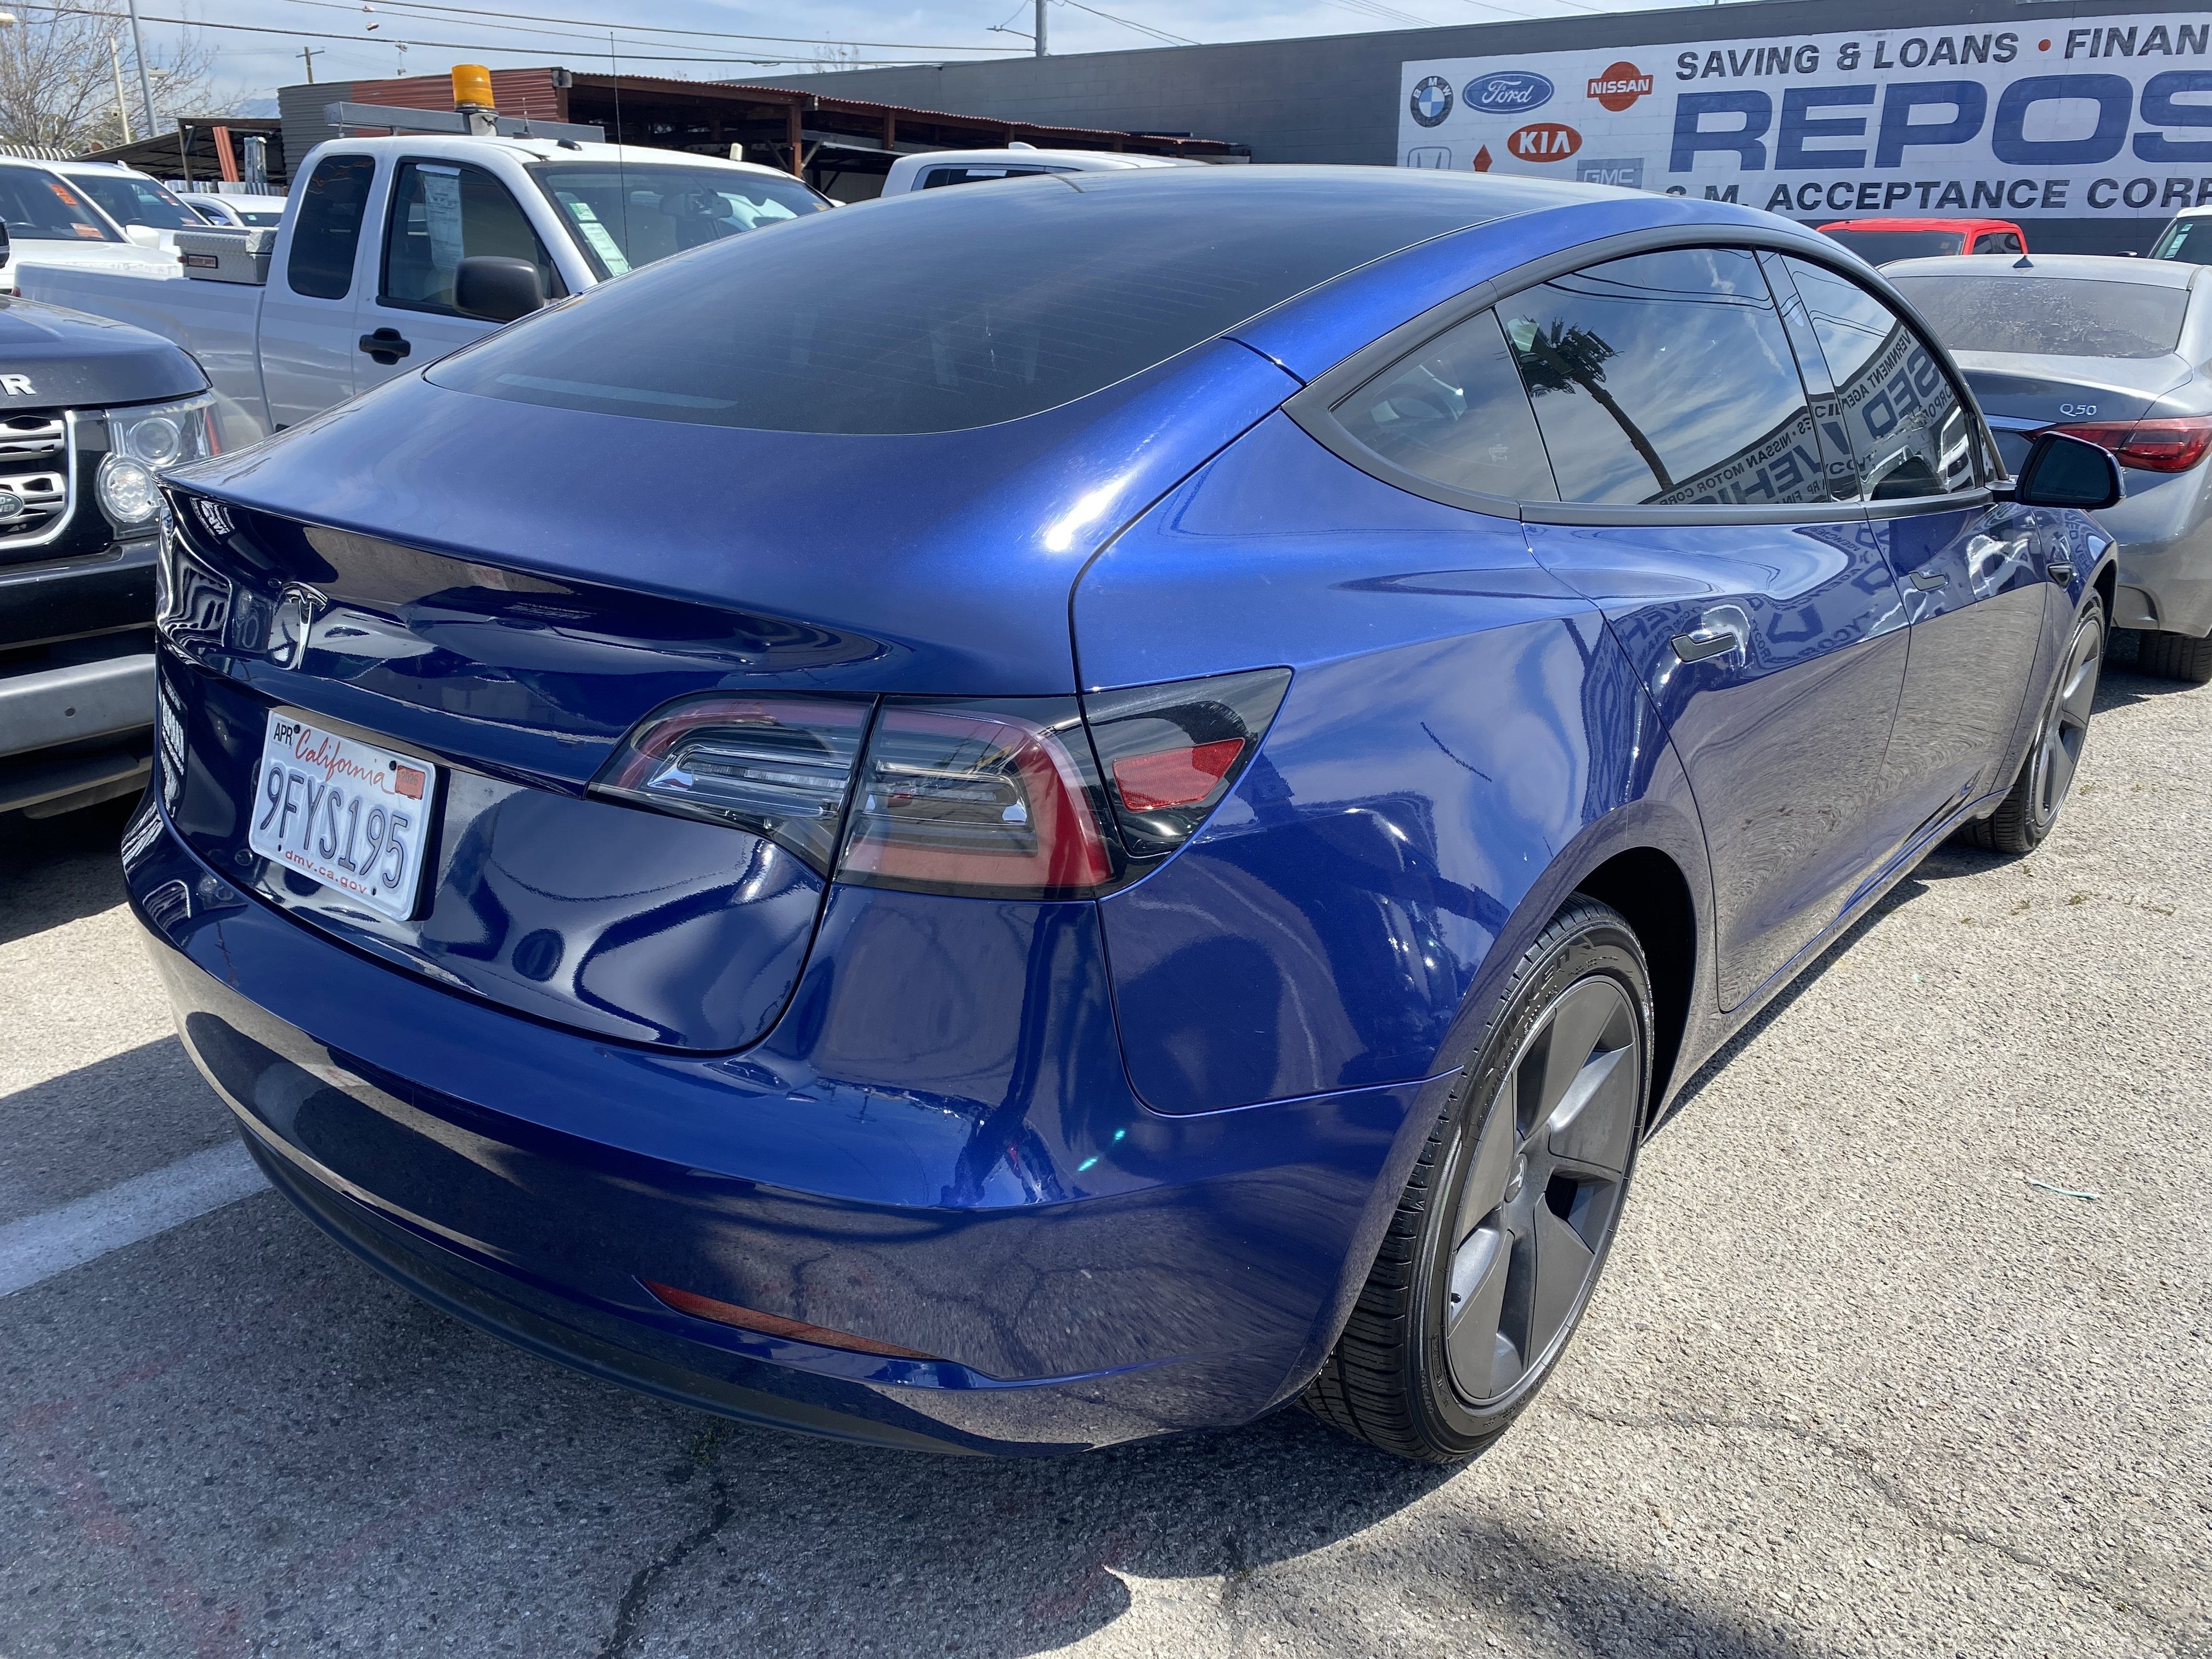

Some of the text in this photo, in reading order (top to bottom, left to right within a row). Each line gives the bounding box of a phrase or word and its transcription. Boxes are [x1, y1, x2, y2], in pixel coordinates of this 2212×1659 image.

[1675, 24, 2210, 81] SAVING & LOANS FINAN
[1414, 76, 1452, 99] BMW
[1481, 80, 1535, 104] Ford
[1590, 78, 1650, 94] NISSAN
[1519, 131, 1571, 154] KIA
[1583, 168, 1635, 184] GMC
[1764, 179, 2070, 212] ACCEPTANCE
[2059, 403, 2097, 417] Q50
[273, 722, 419, 795] APR California 2026
[259, 766, 409, 889] 9FYS195
[285, 849, 368, 895] dmv.ca.gov
